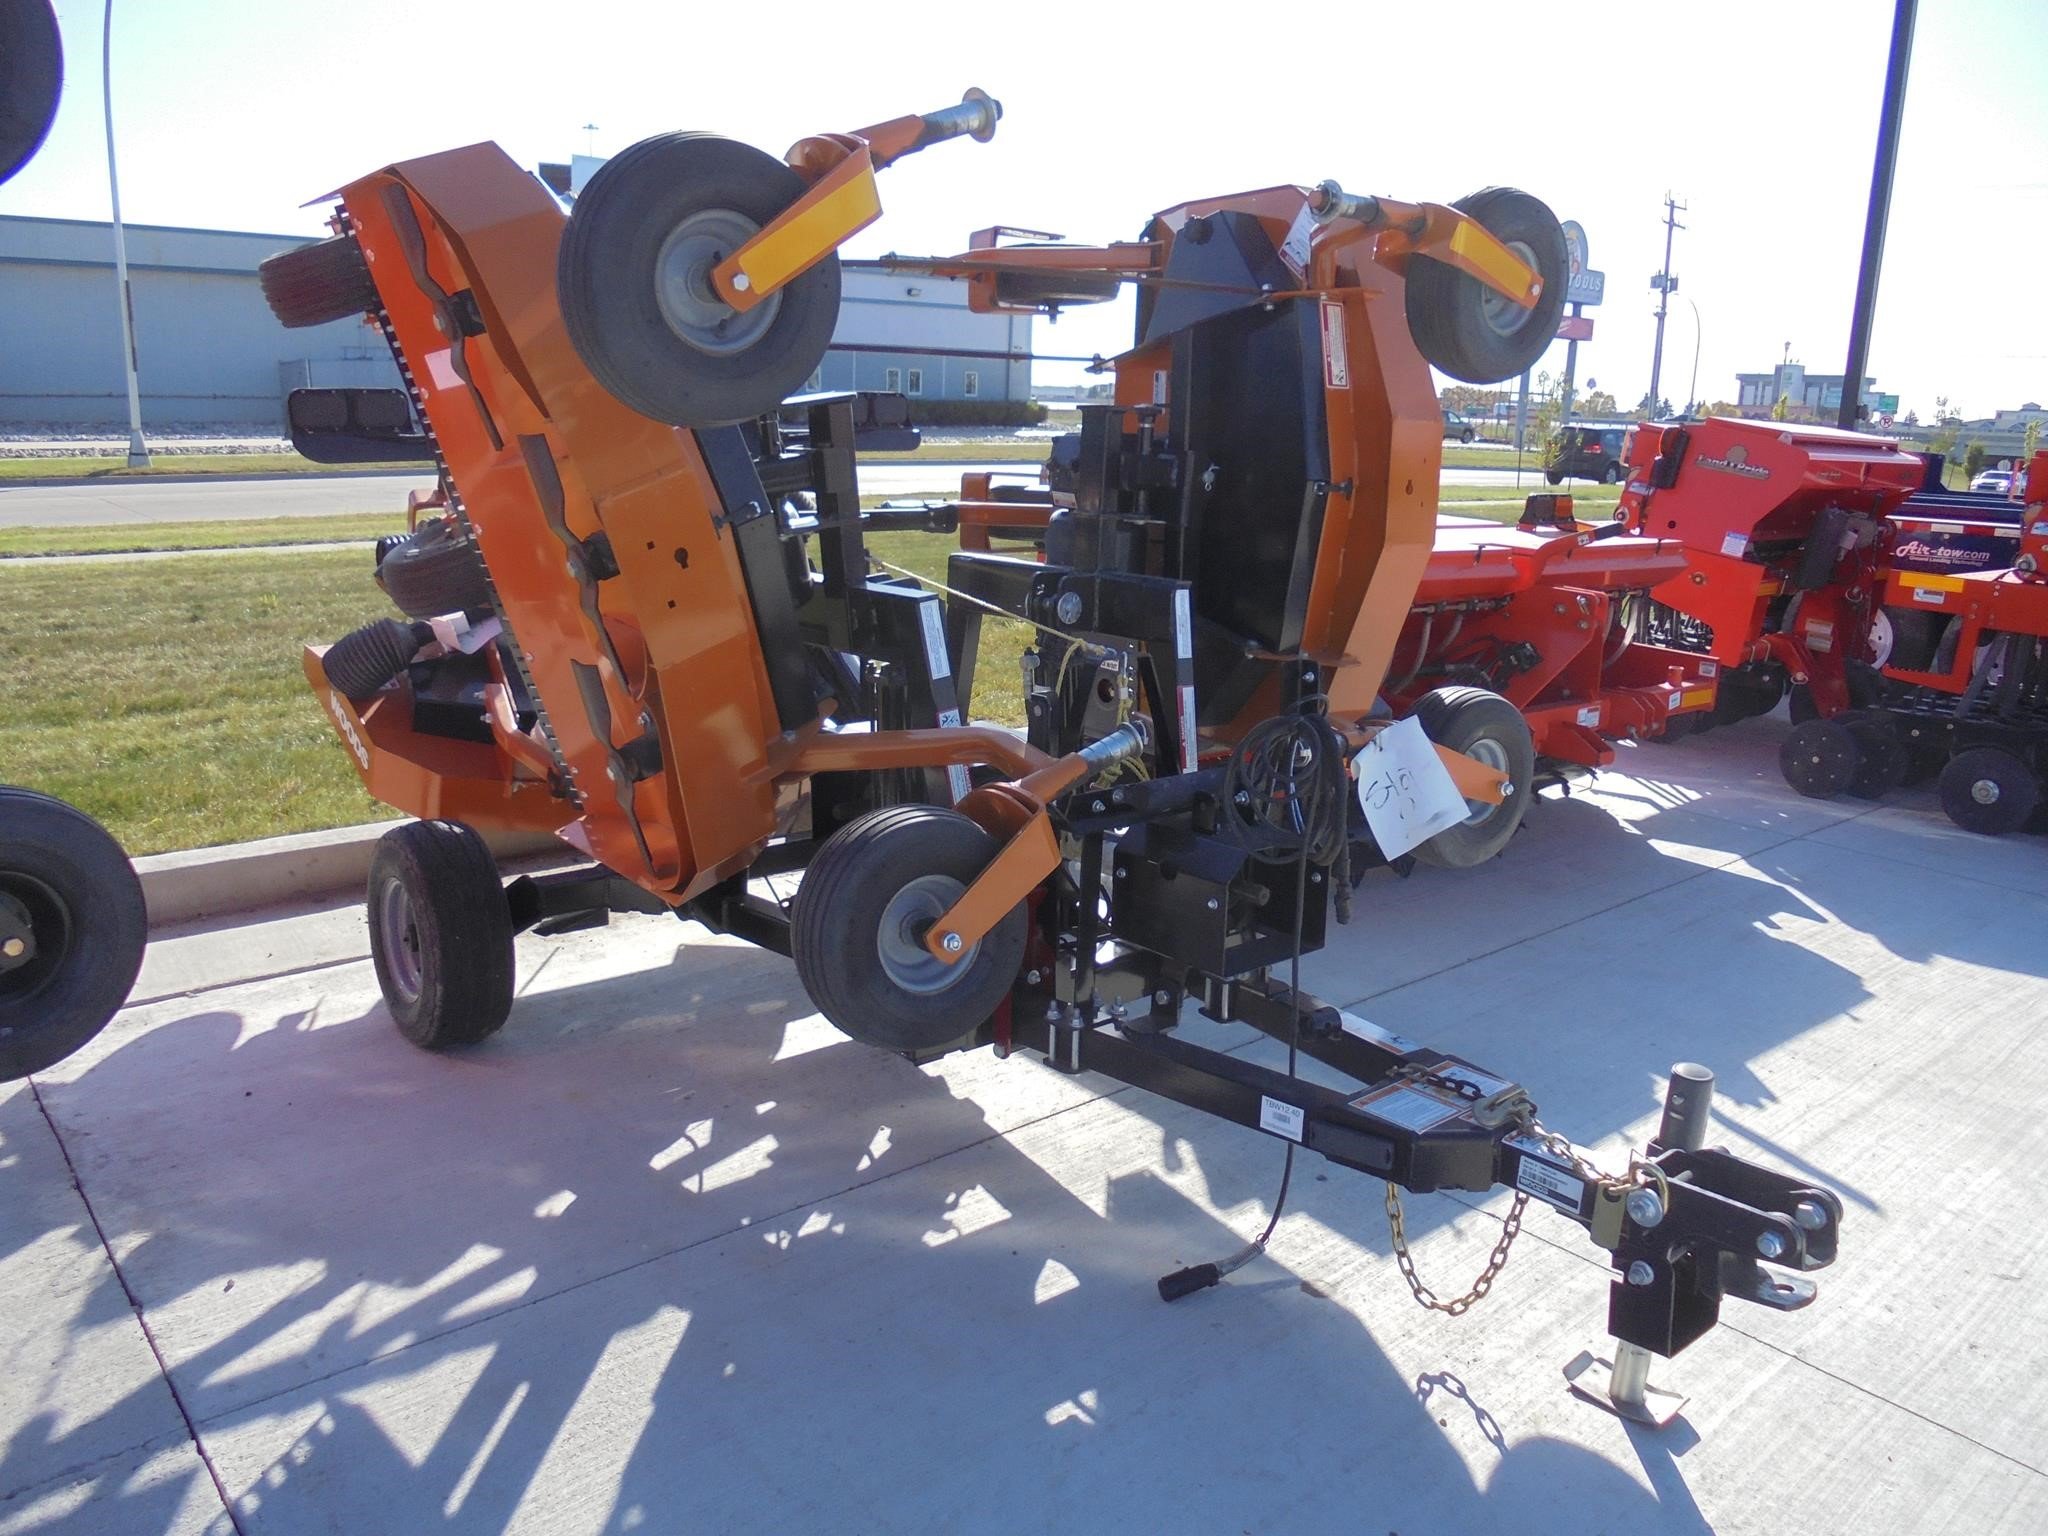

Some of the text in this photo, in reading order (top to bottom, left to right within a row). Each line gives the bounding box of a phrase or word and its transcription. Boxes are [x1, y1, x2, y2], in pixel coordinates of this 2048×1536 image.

[1568, 273, 1602, 292] TOOLS
[1698, 454, 1728, 468] Land
[1895, 541, 1990, 559] Air-tow.com
[330, 689, 369, 770] WOODS
